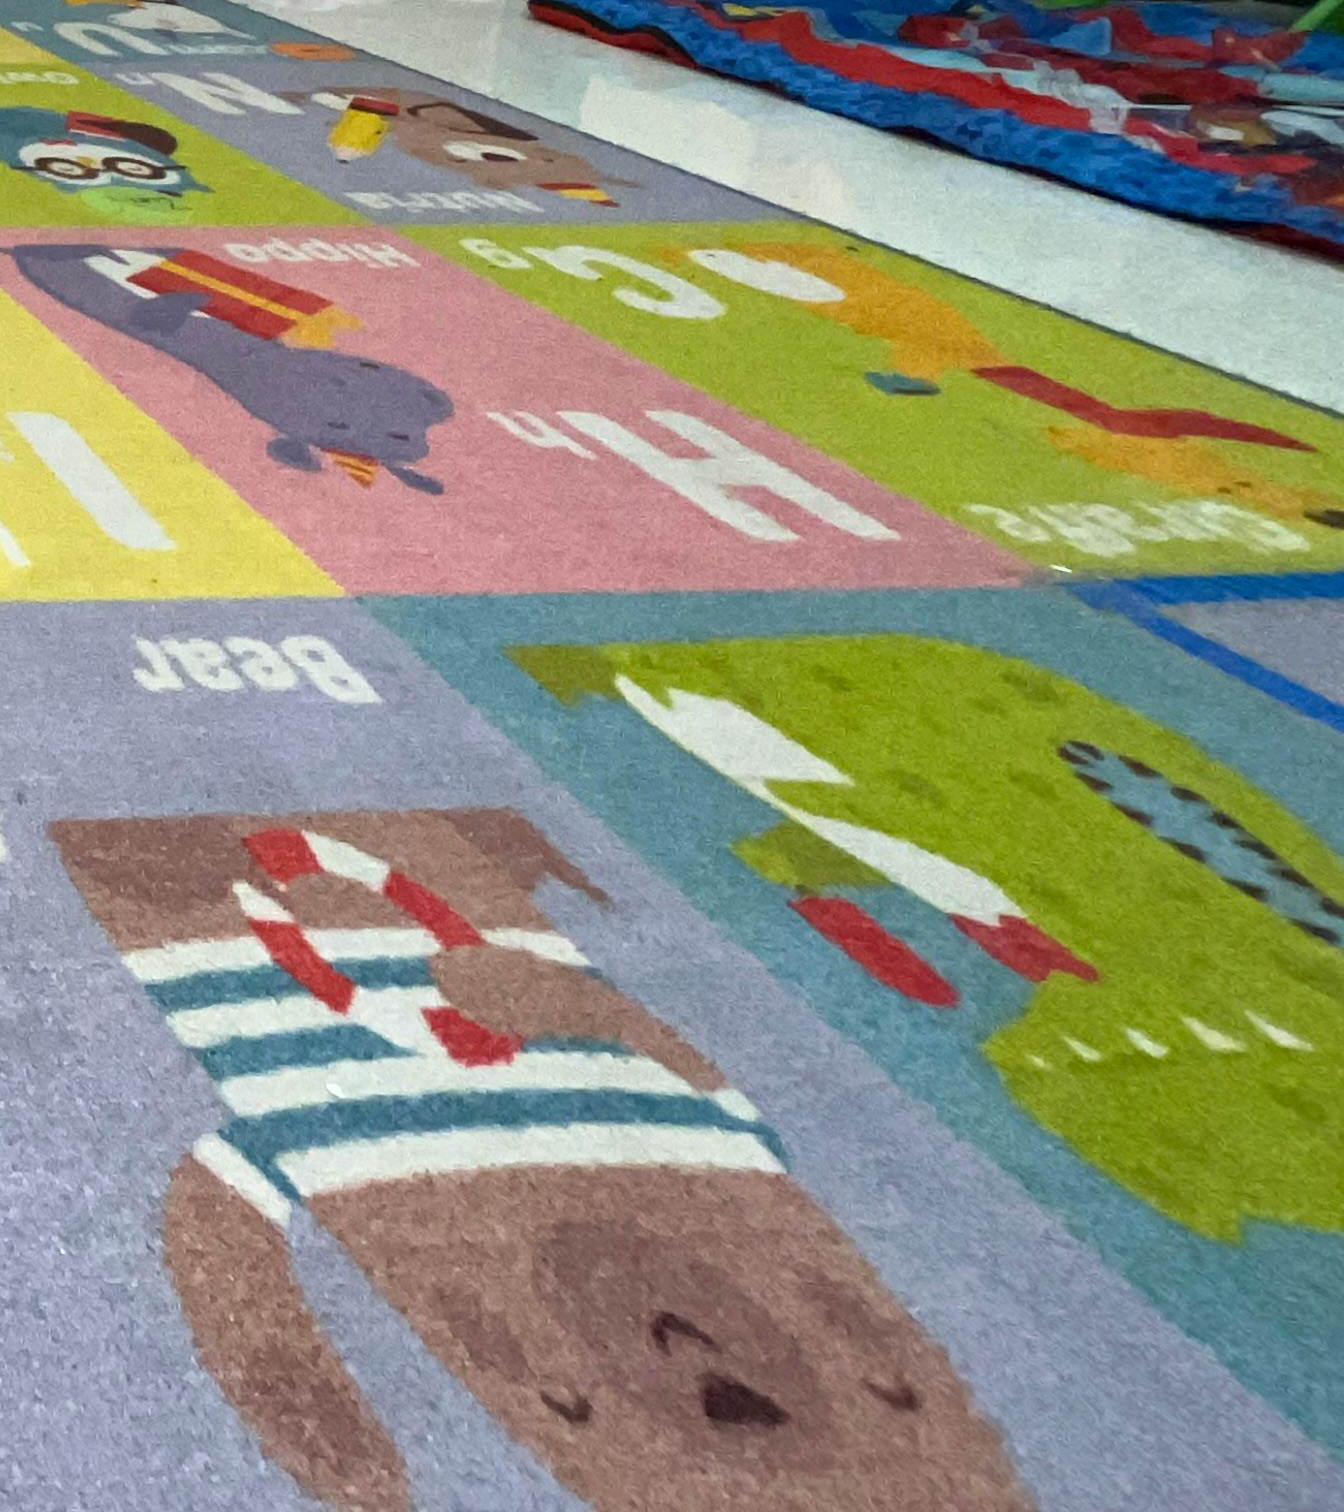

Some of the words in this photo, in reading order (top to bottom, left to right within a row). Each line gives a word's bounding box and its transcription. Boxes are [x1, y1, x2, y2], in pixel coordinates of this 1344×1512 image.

[224, 236, 422, 270] Hippo
[557, 409, 904, 545] H
[132, 634, 383, 705] Bear
